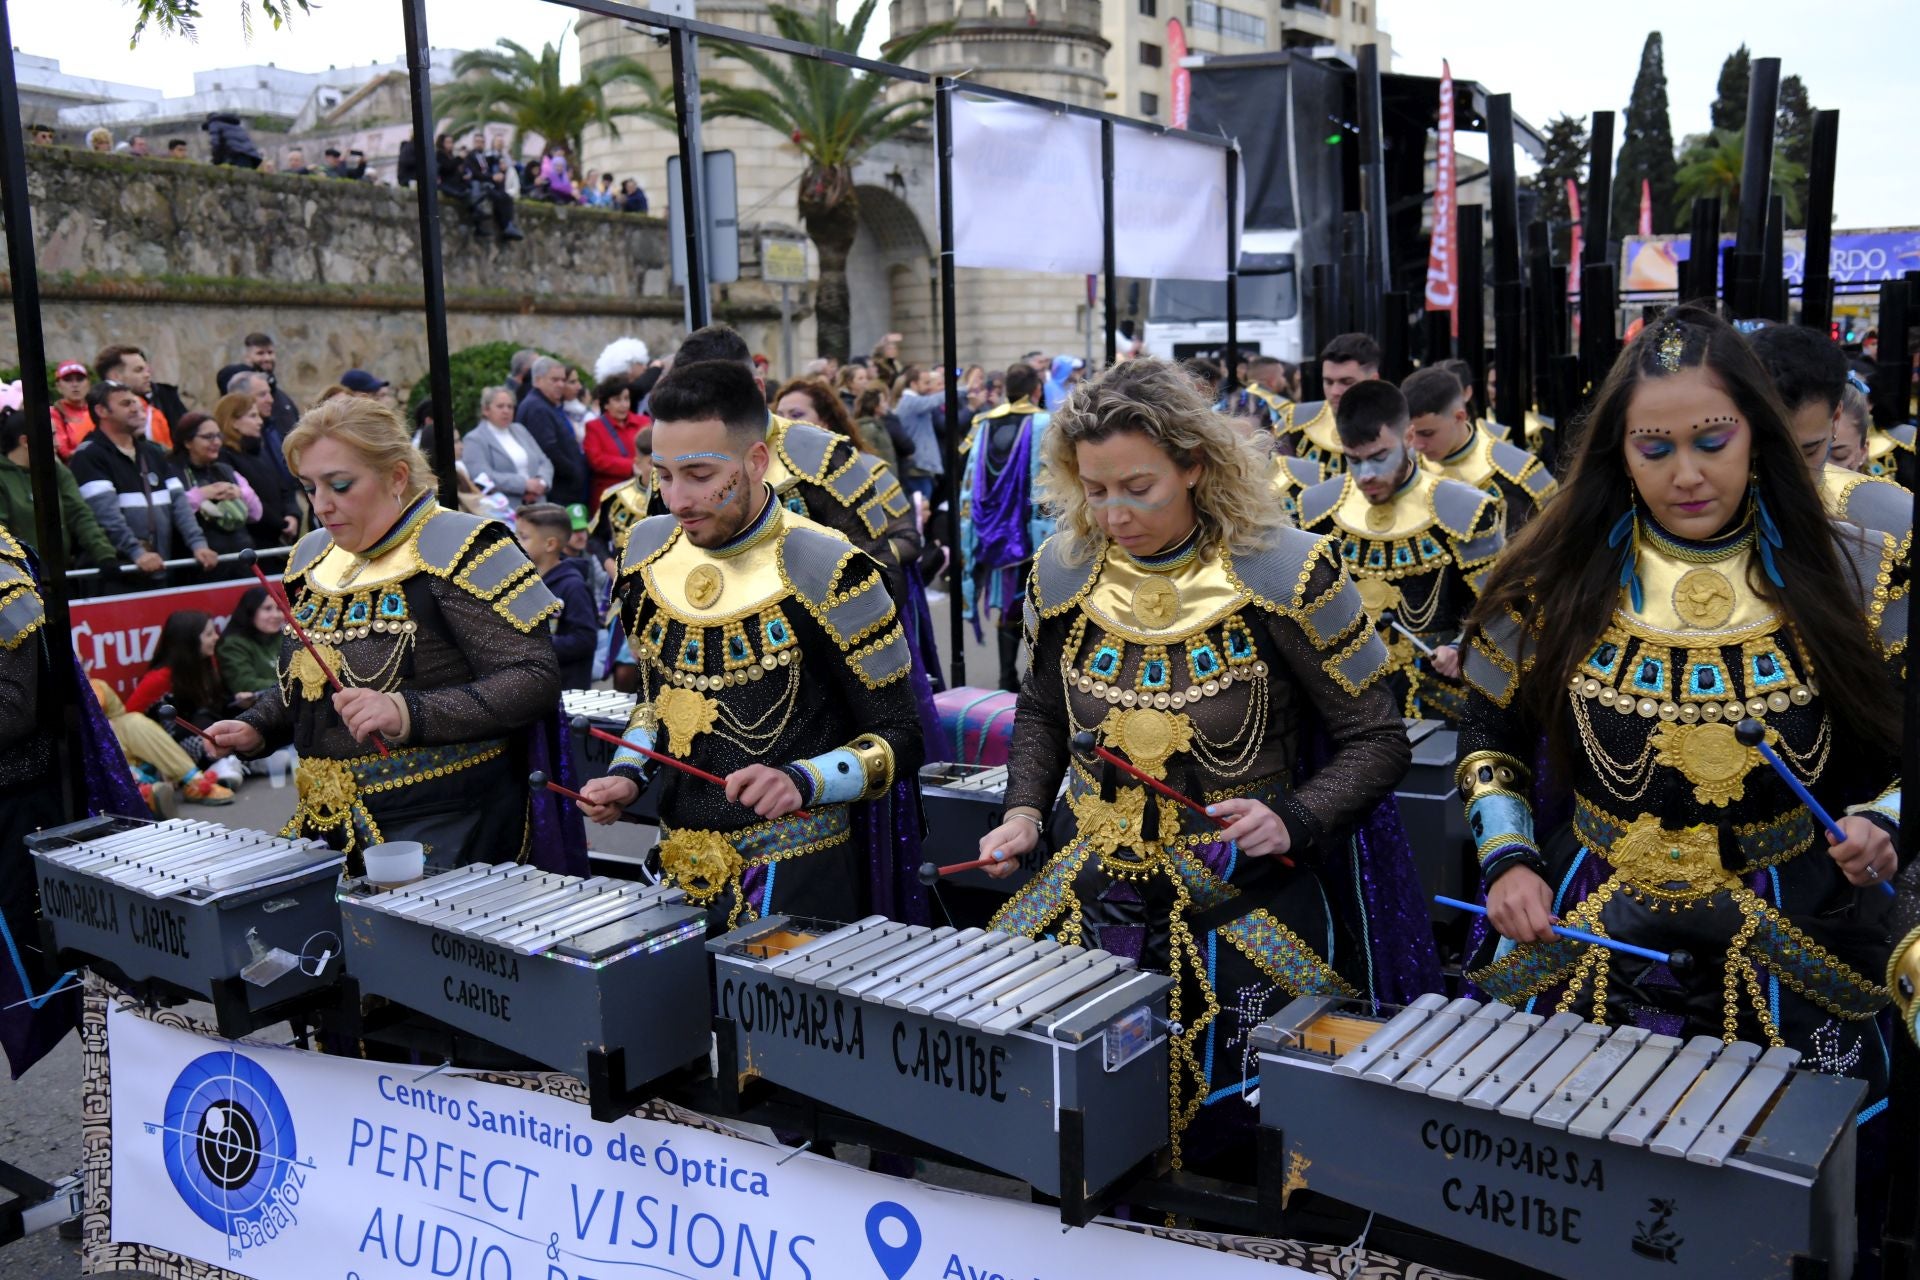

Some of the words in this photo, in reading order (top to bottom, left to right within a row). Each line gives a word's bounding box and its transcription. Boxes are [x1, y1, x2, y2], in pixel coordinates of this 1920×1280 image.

[43, 876, 119, 934] COMPARSA
[129, 902, 190, 959] CARIBE
[431, 932, 519, 982] COMPARSA
[443, 975, 511, 1022] CARIBE
[722, 979, 865, 1060] COMPARSA
[892, 1021, 1007, 1103] CARIBE
[378, 1075, 460, 1121] Centro
[467, 1100, 592, 1157] Sanitario
[607, 1133, 646, 1166] de
[655, 1140, 769, 1197] Óptica
[1421, 1119, 1604, 1192] COMPARSA
[235, 1164, 306, 1249] Badajoz
[347, 1118, 539, 1221] PERFECT
[571, 1183, 815, 1280] VISIONS
[1442, 1177, 1581, 1244] CARIBE
[358, 1207, 512, 1280] AUDIO
[547, 1232, 560, 1262] &
